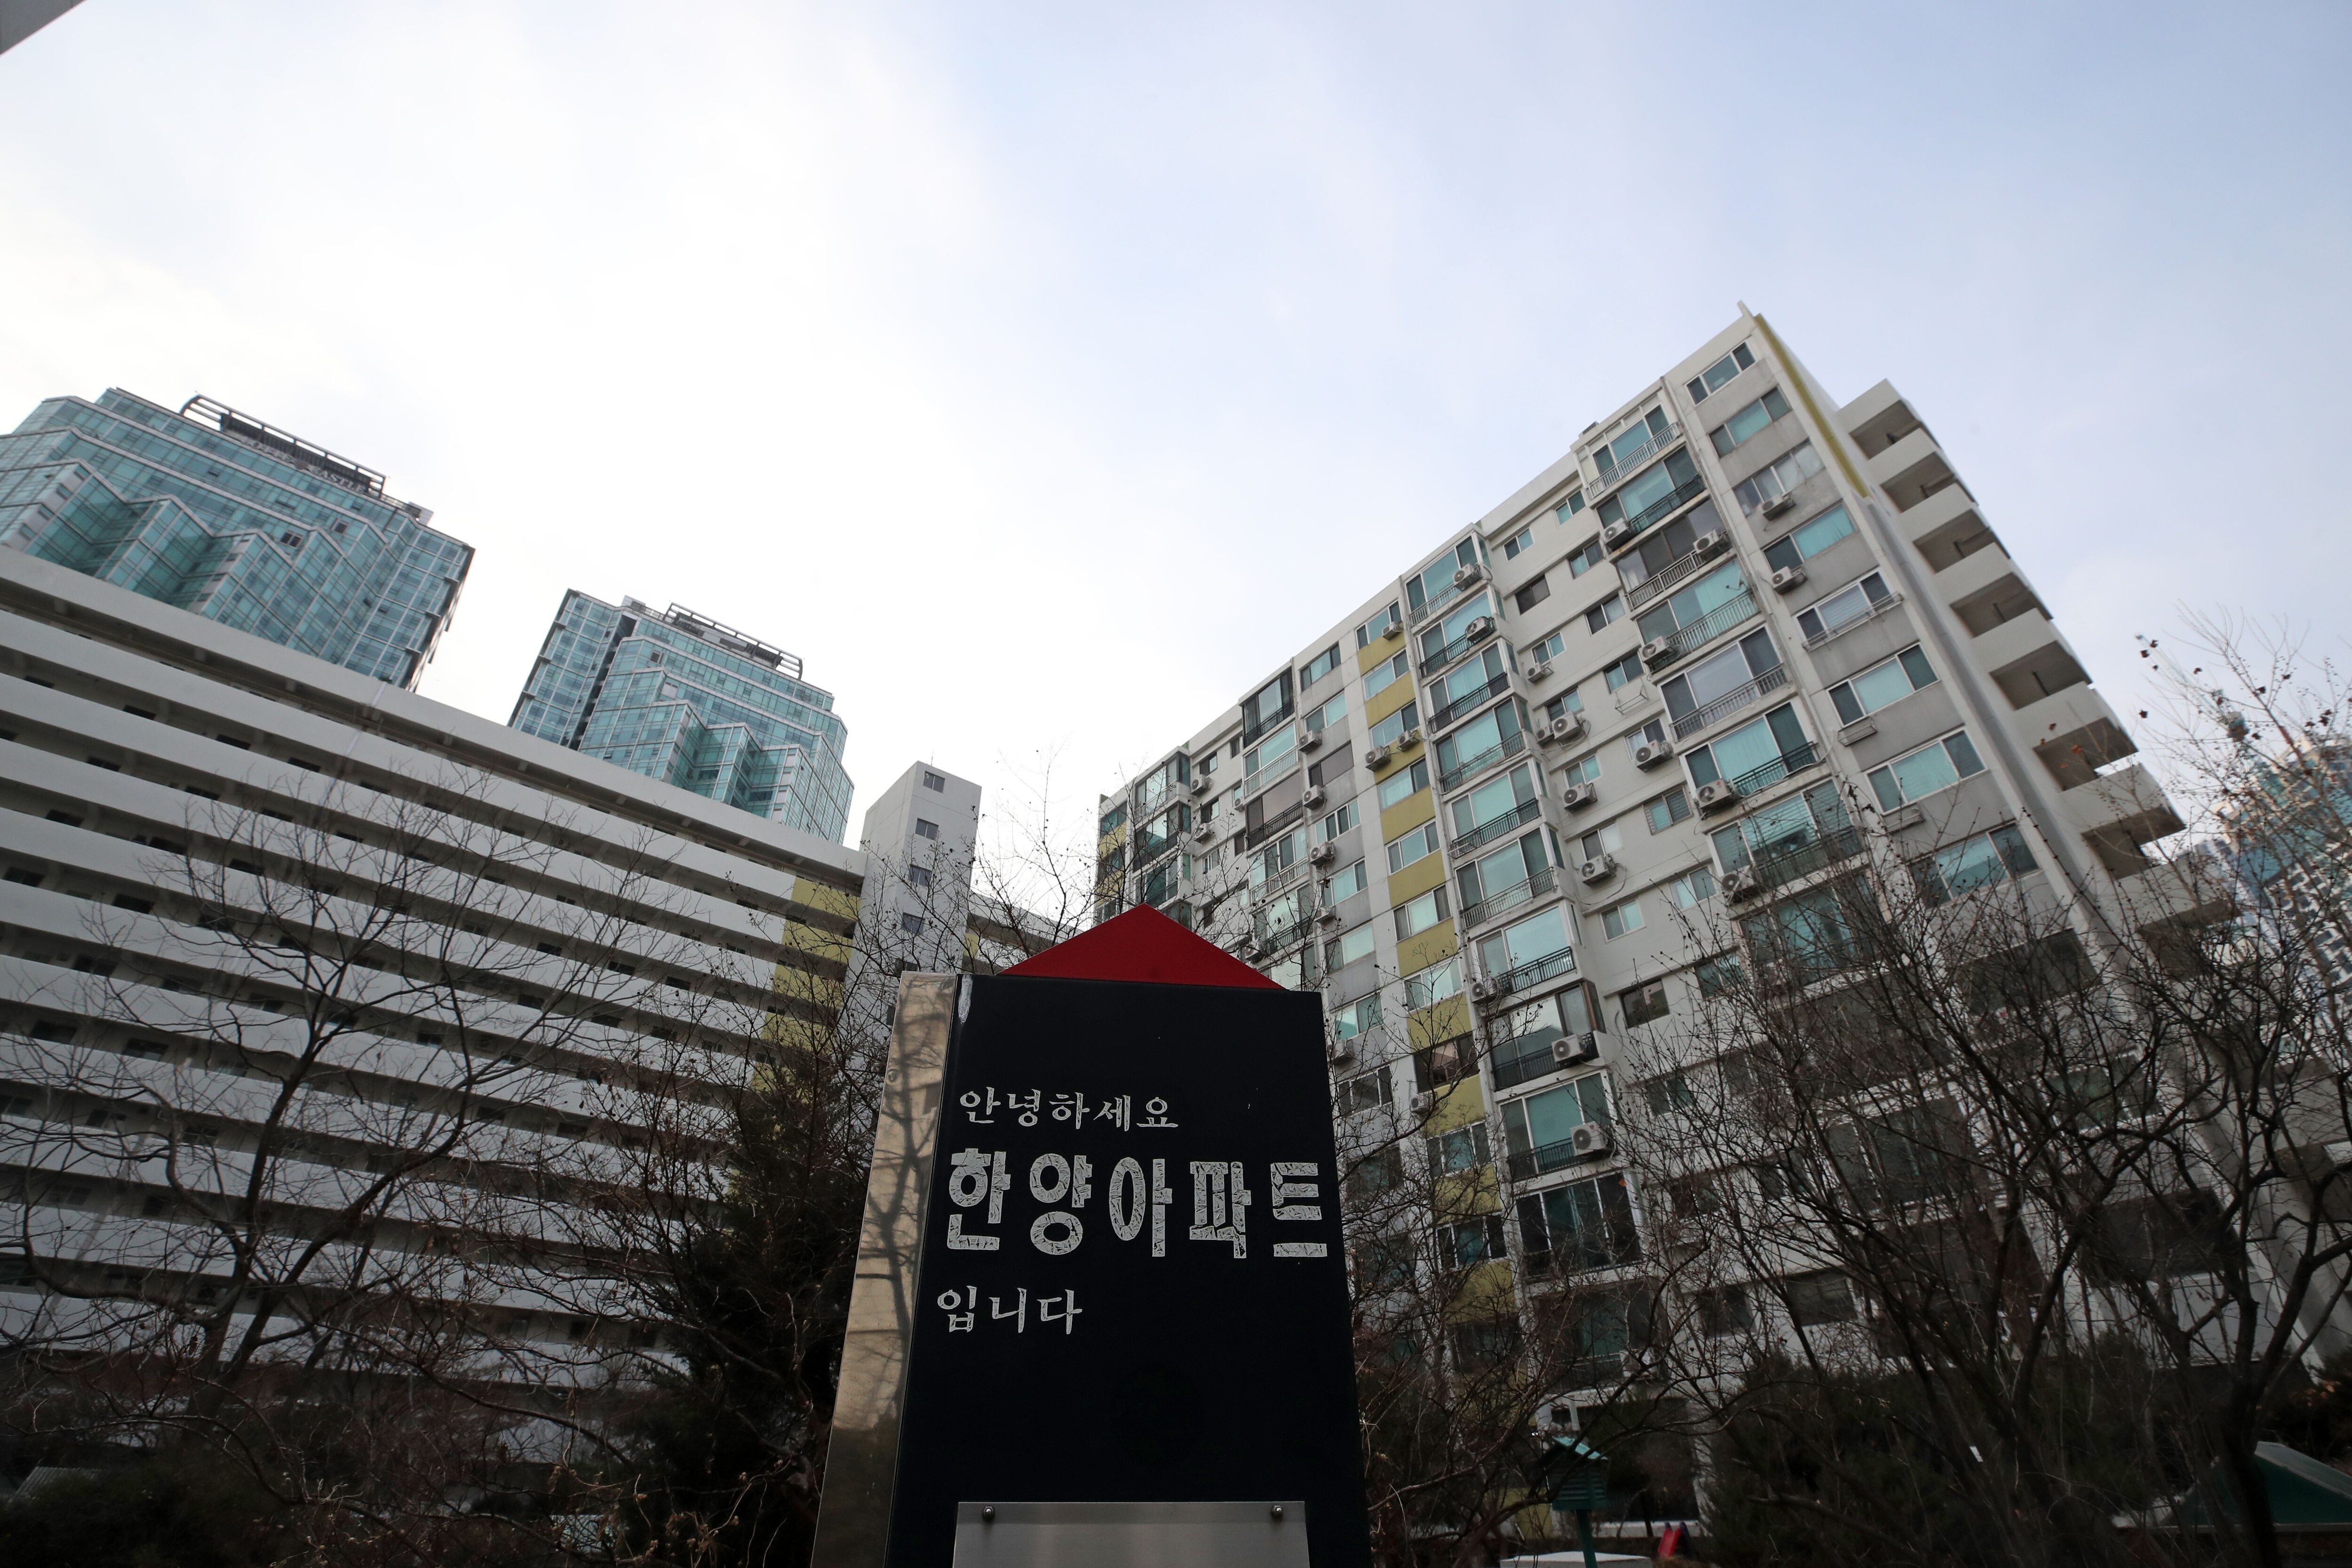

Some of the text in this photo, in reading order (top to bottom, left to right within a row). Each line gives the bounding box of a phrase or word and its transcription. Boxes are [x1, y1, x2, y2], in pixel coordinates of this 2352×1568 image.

[959, 1086, 1179, 1132] 안녕하세요
[946, 1148, 1328, 1259] 한양아파트
[937, 1285, 1083, 1335] 입니다
